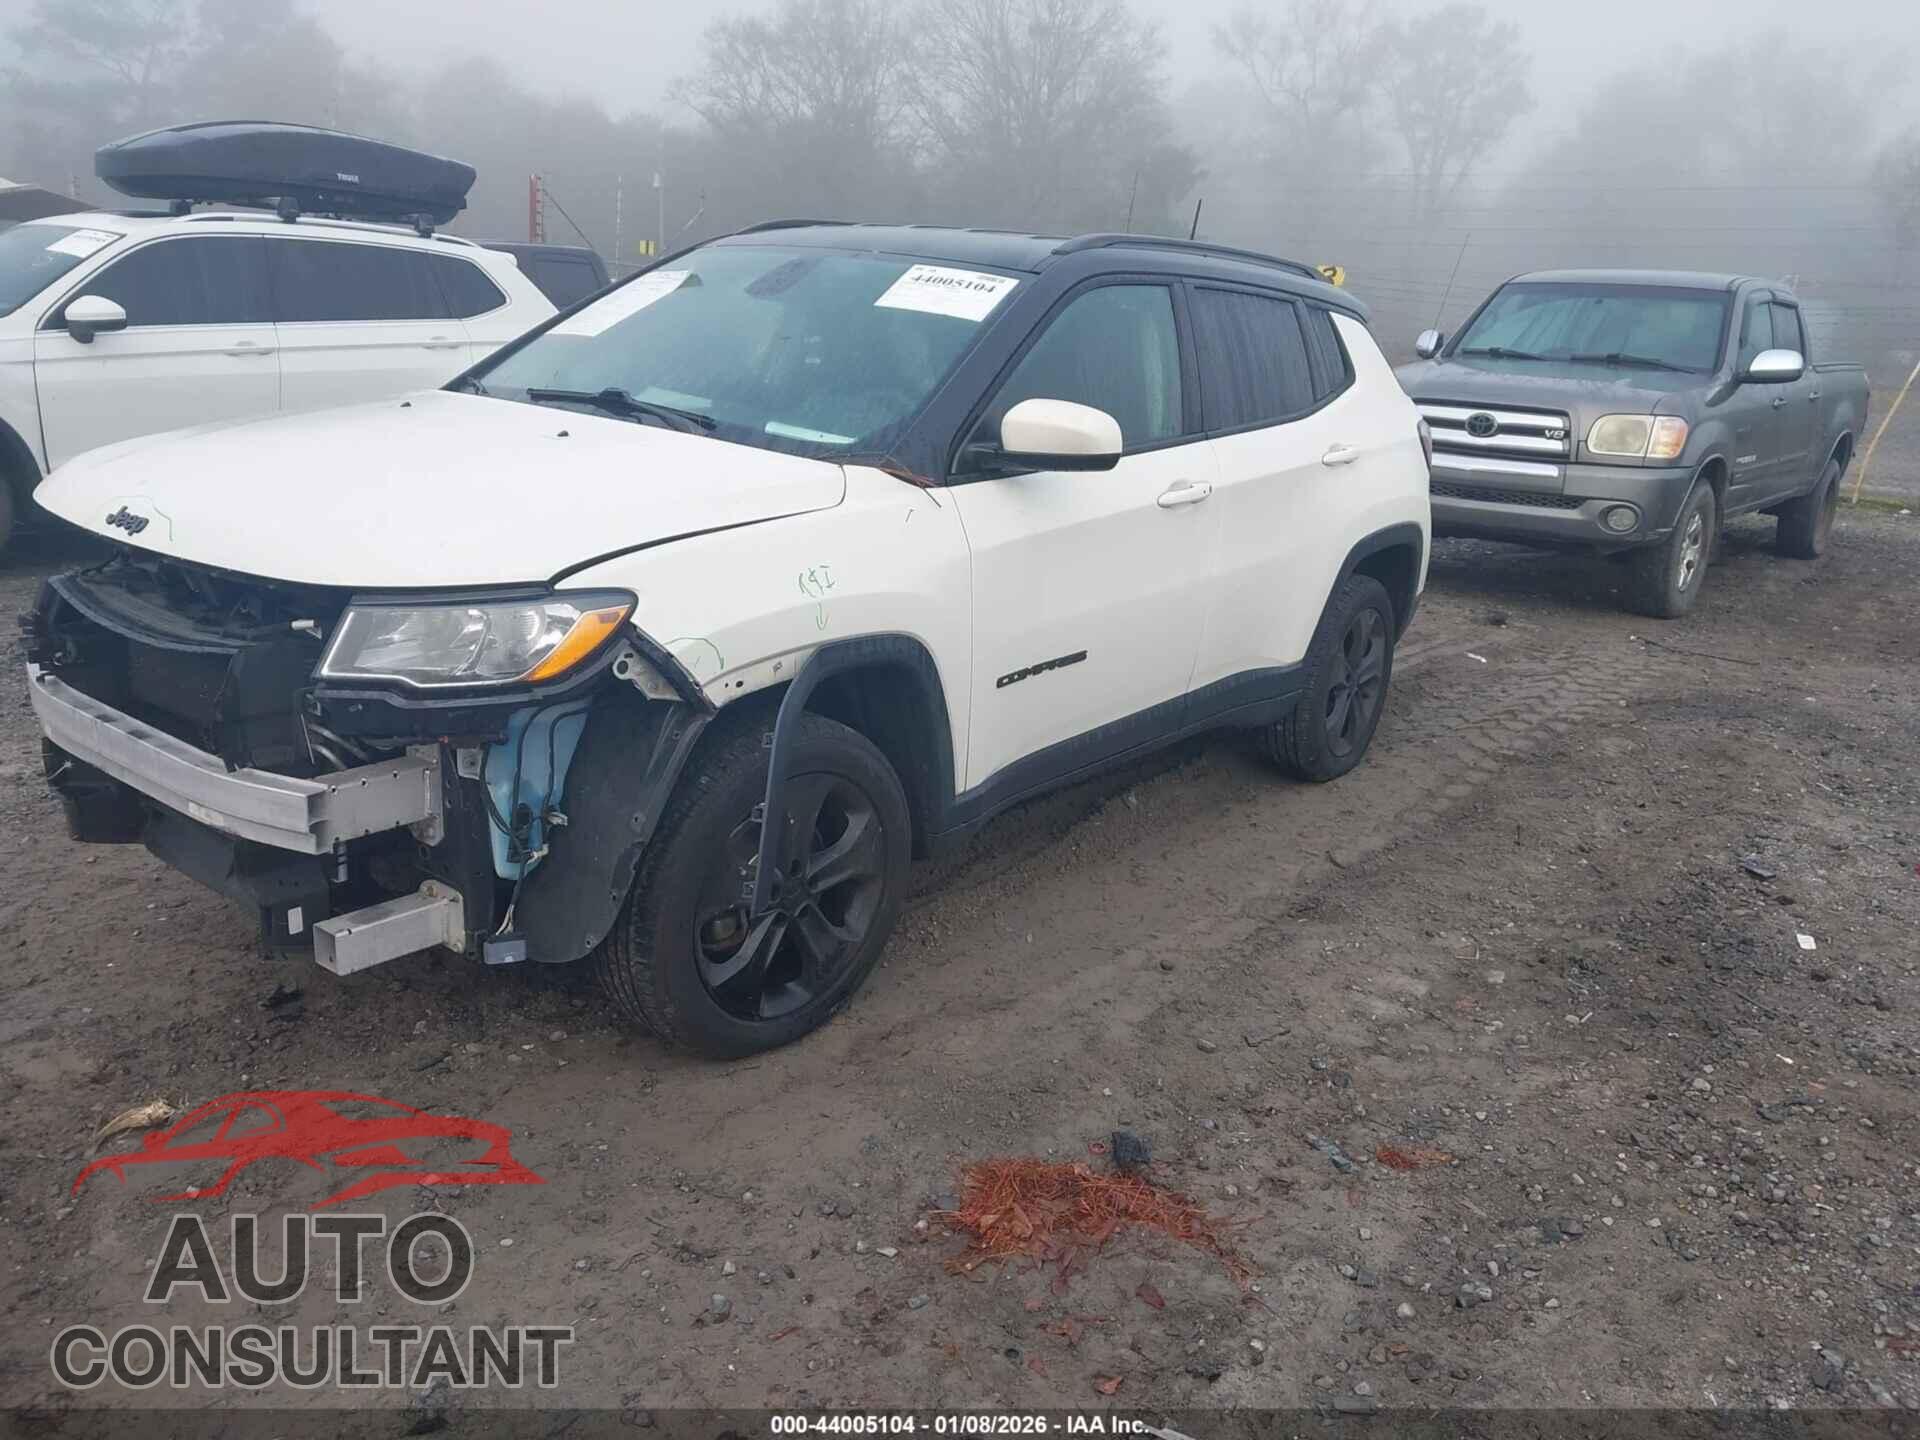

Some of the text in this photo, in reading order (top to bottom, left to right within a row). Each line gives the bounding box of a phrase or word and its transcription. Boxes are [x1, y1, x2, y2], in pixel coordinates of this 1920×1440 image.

[911, 273, 996, 294] 44005104
[1544, 429, 1566, 440] V8
[105, 506, 150, 536] Jeep
